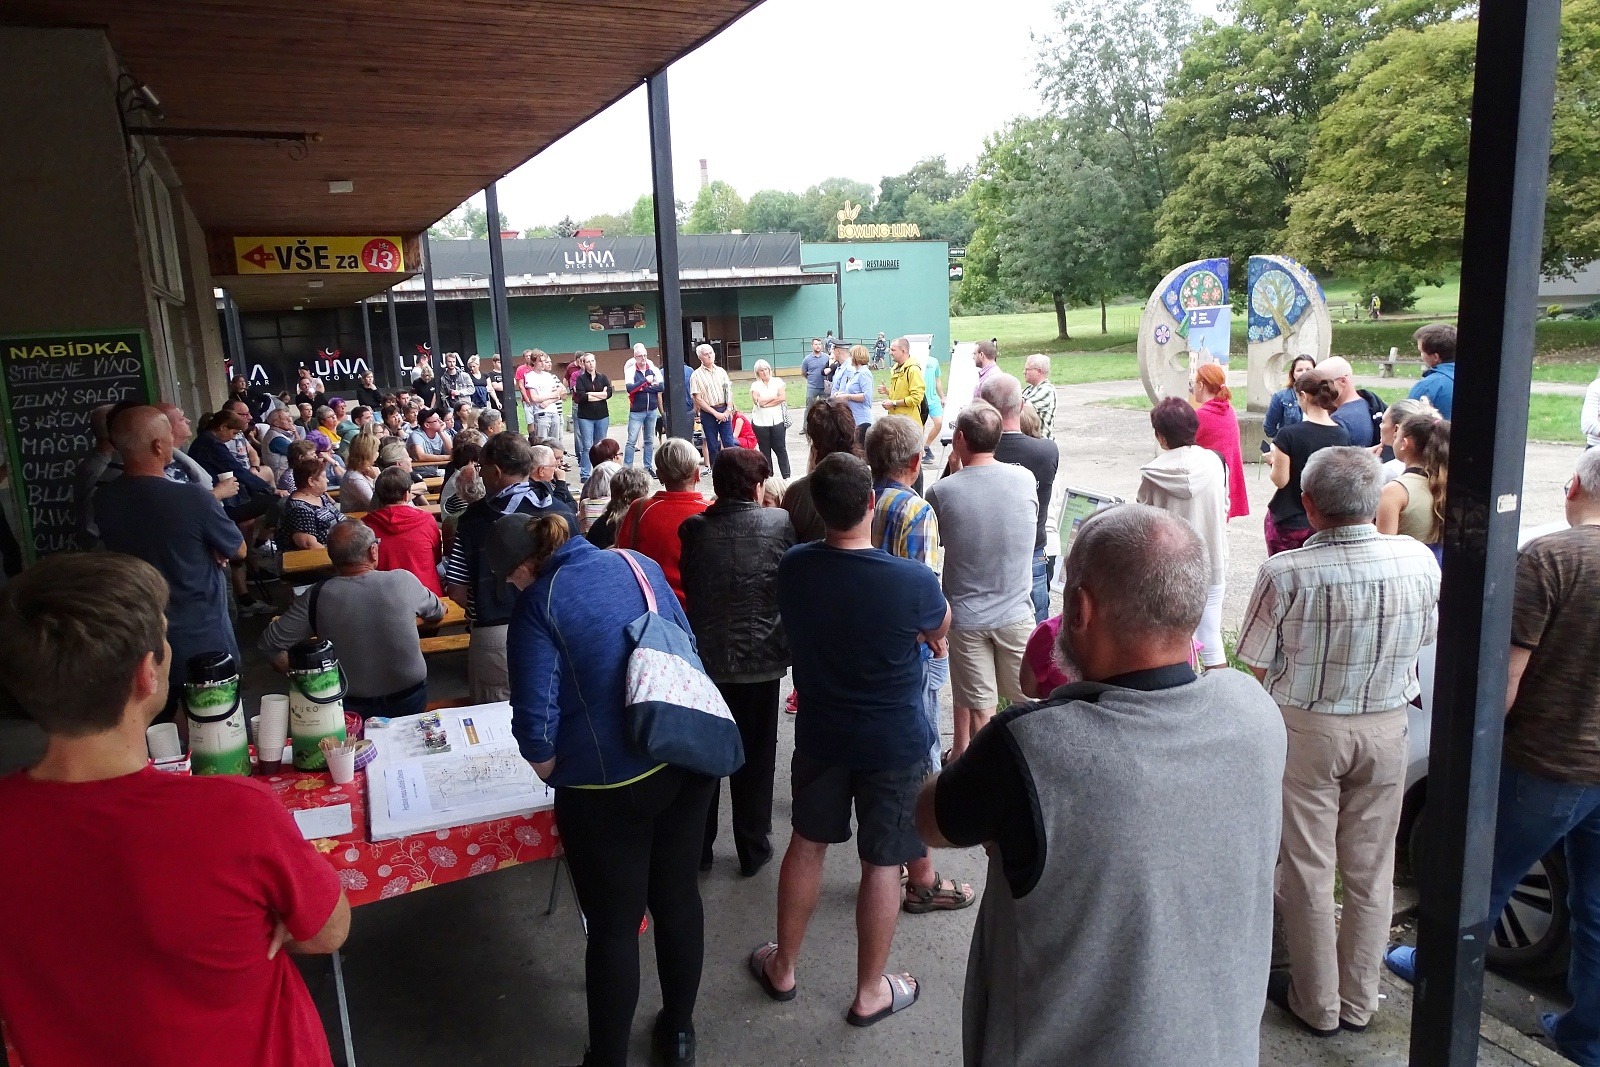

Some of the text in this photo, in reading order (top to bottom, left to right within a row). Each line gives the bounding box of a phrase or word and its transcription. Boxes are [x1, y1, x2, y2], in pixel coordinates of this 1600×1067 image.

[838, 223, 920, 238] BOWLING LUNA
[274, 240, 330, 270] VŠE
[336, 255, 359, 269] za
[368, 248, 394, 270] 13
[564, 250, 615, 264] LUNA
[9, 341, 132, 360] NABÍDKA
[93, 355, 141, 376] VÍNO
[73, 382, 136, 404] SALÁT
[35, 409, 93, 430] KŘEN
[22, 458, 84, 480] CHER
[28, 484, 75, 506] BLU
[32, 507, 76, 528] KIW
